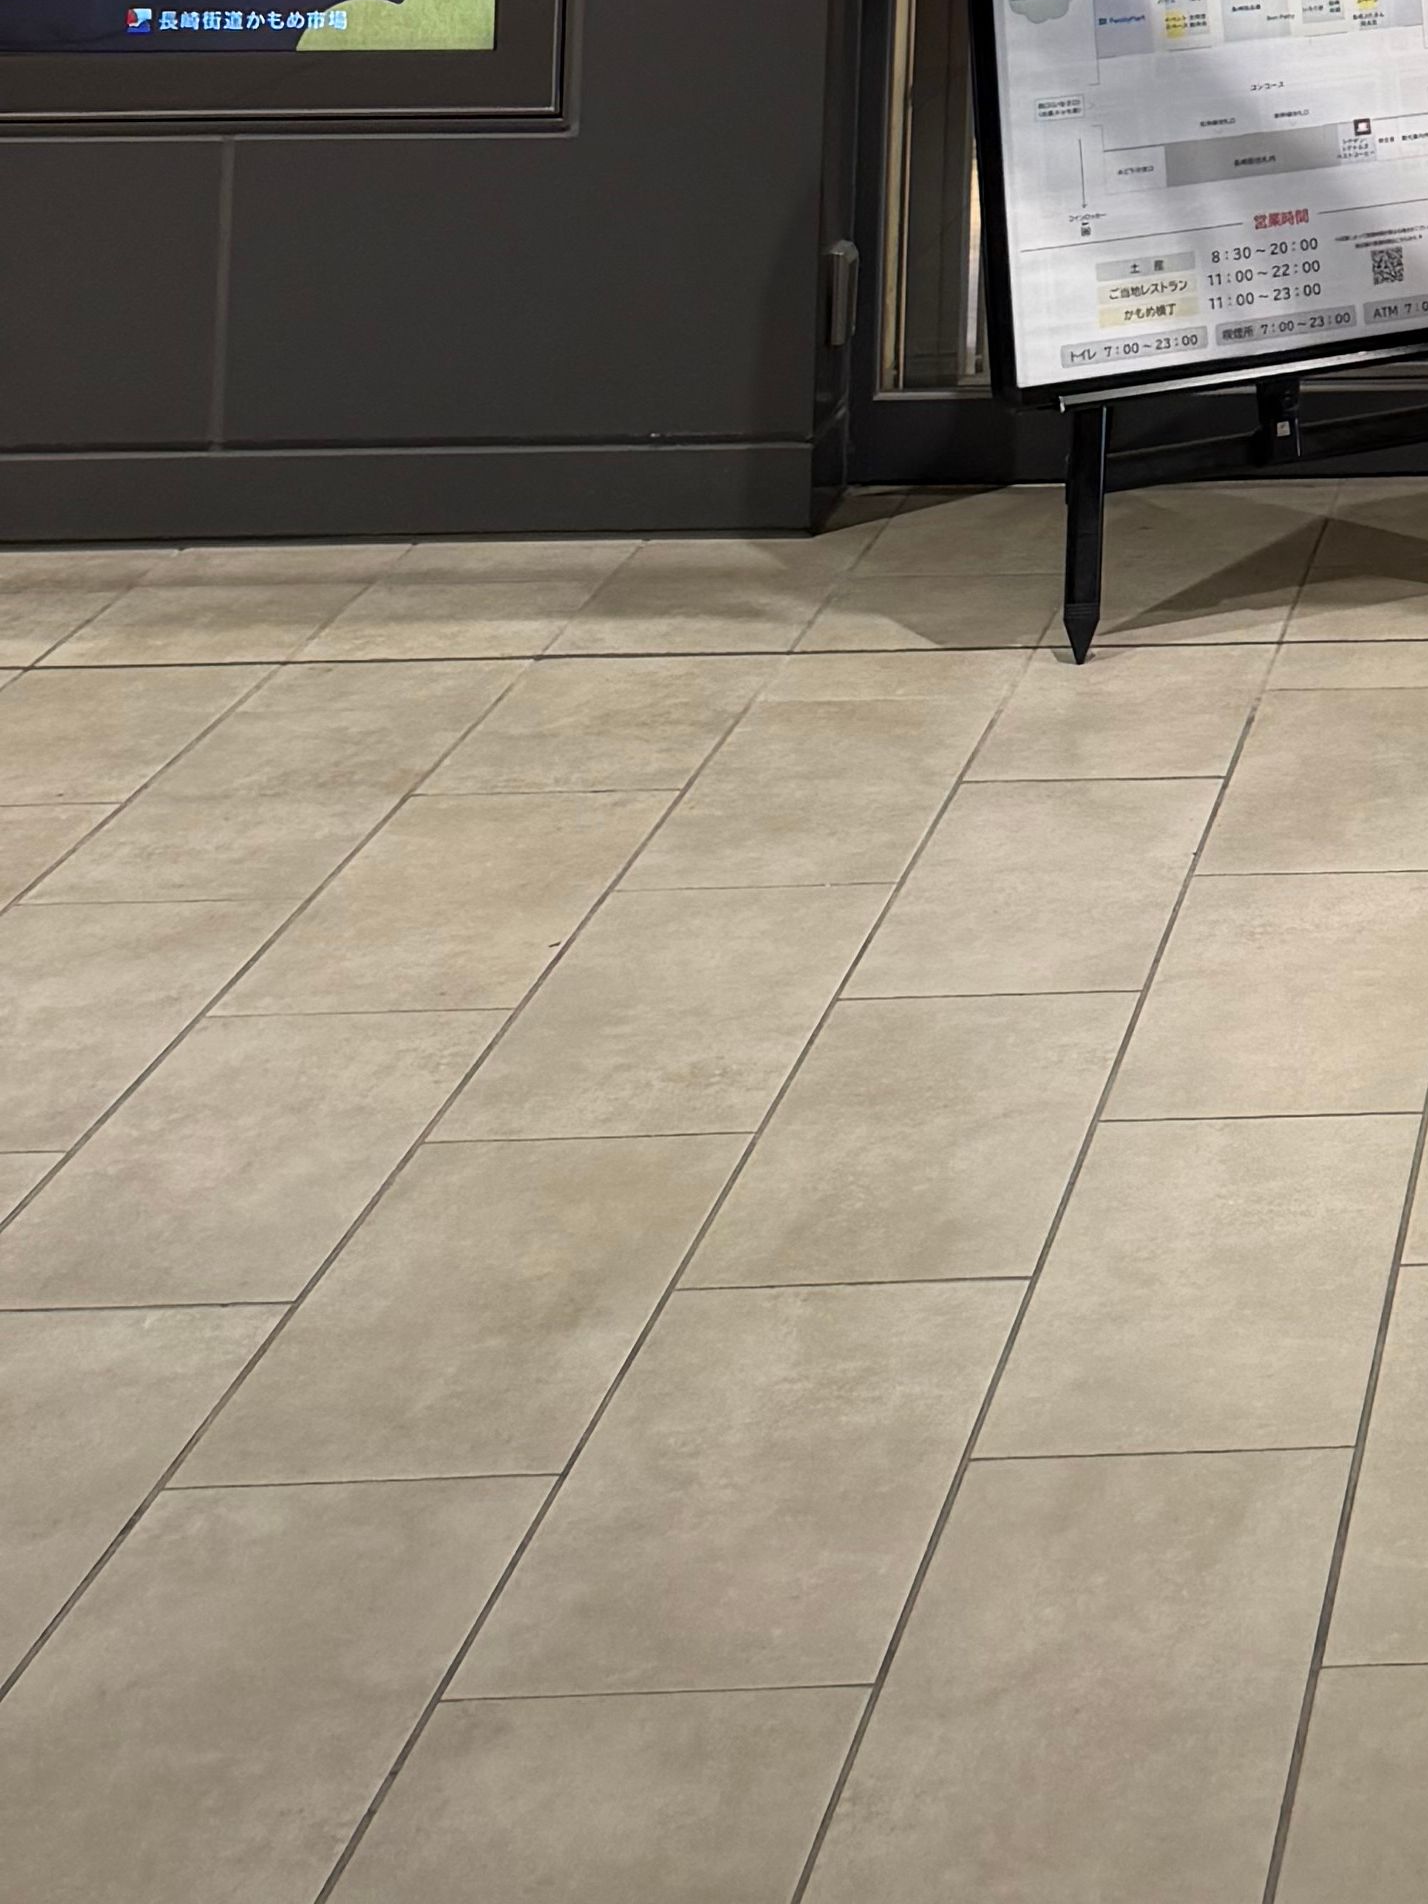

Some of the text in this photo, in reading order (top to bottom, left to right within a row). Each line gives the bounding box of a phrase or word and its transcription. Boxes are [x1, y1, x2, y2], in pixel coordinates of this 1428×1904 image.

[158, 8, 349, 31] 長崎街道かもめ市場
[1252, 208, 1310, 232] 営業時間
[1108, 279, 1188, 300] ご当地レストラン
[1124, 303, 1177, 321] かもめ横丁
[1373, 305, 1399, 319] ATM
[1070, 347, 1097, 363] トイレ
